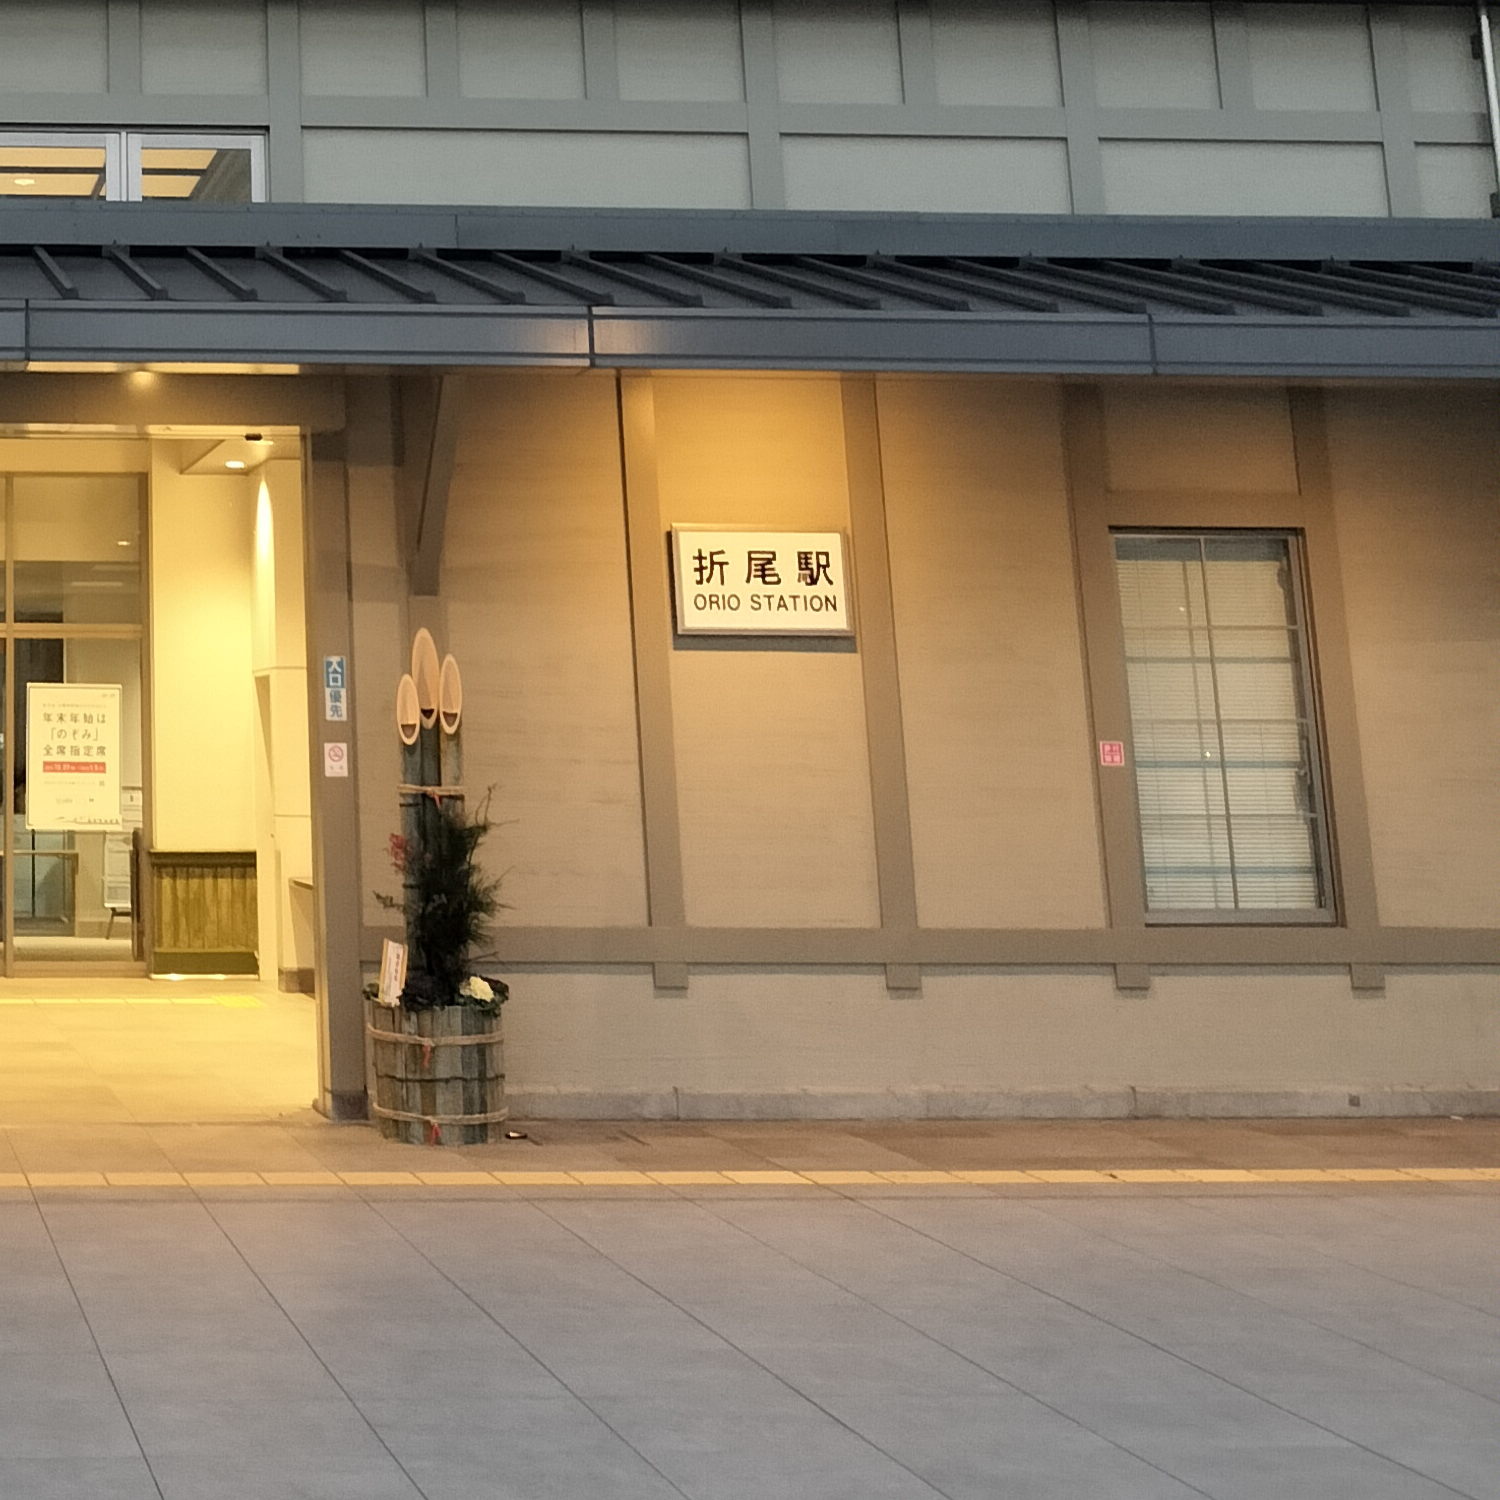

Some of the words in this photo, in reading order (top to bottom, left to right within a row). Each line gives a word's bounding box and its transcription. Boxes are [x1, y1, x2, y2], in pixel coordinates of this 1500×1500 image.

[692, 548, 834, 586] 折尾駅
[693, 593, 741, 611] ORIO
[750, 593, 838, 612] STATION
[328, 658, 343, 719] 入口優先
[43, 712, 106, 724] 年末年始は
[43, 745, 106, 757] 全席指定席
